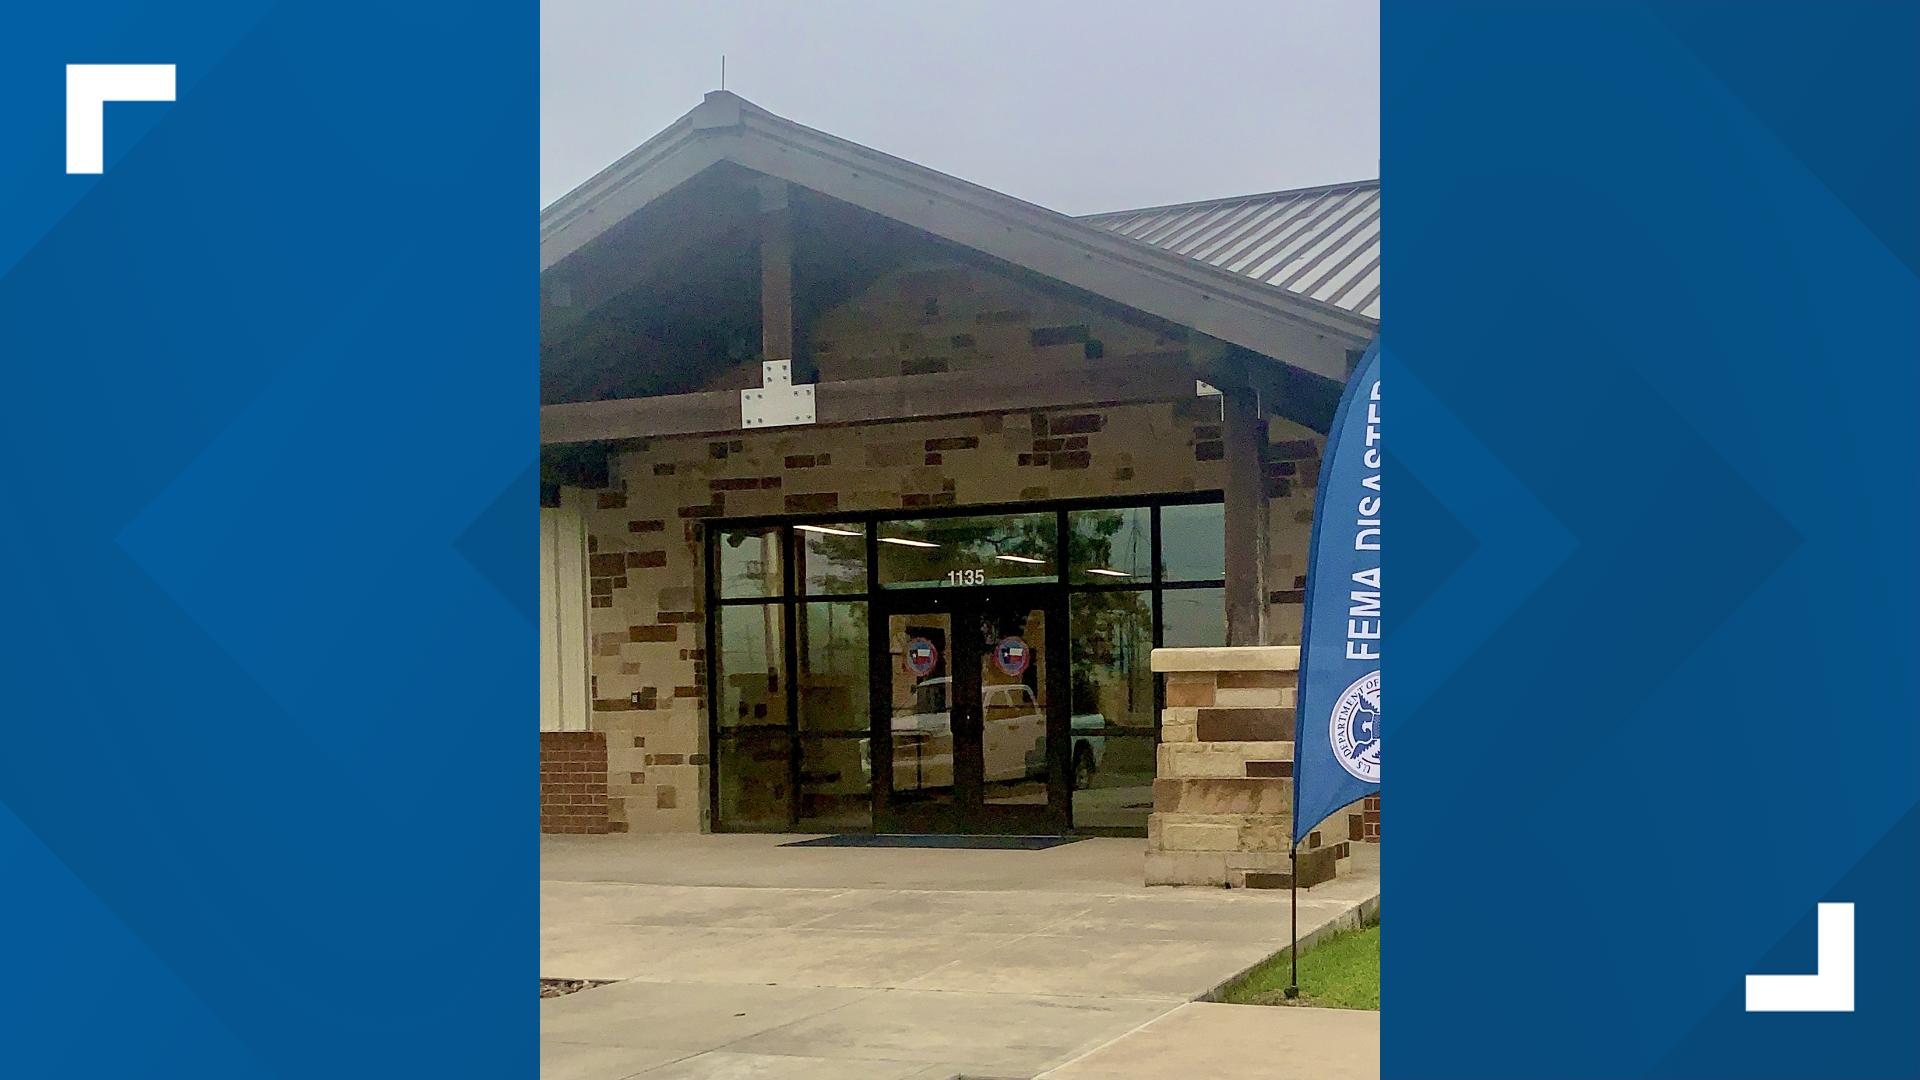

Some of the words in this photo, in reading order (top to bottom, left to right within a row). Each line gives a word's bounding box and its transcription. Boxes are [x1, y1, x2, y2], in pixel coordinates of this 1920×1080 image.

[947, 569, 984, 586] 1135
[1346, 567, 1380, 660] FEMA
[1337, 686, 1363, 758] DEPARTMENT
[1366, 679, 1379, 689] OF
